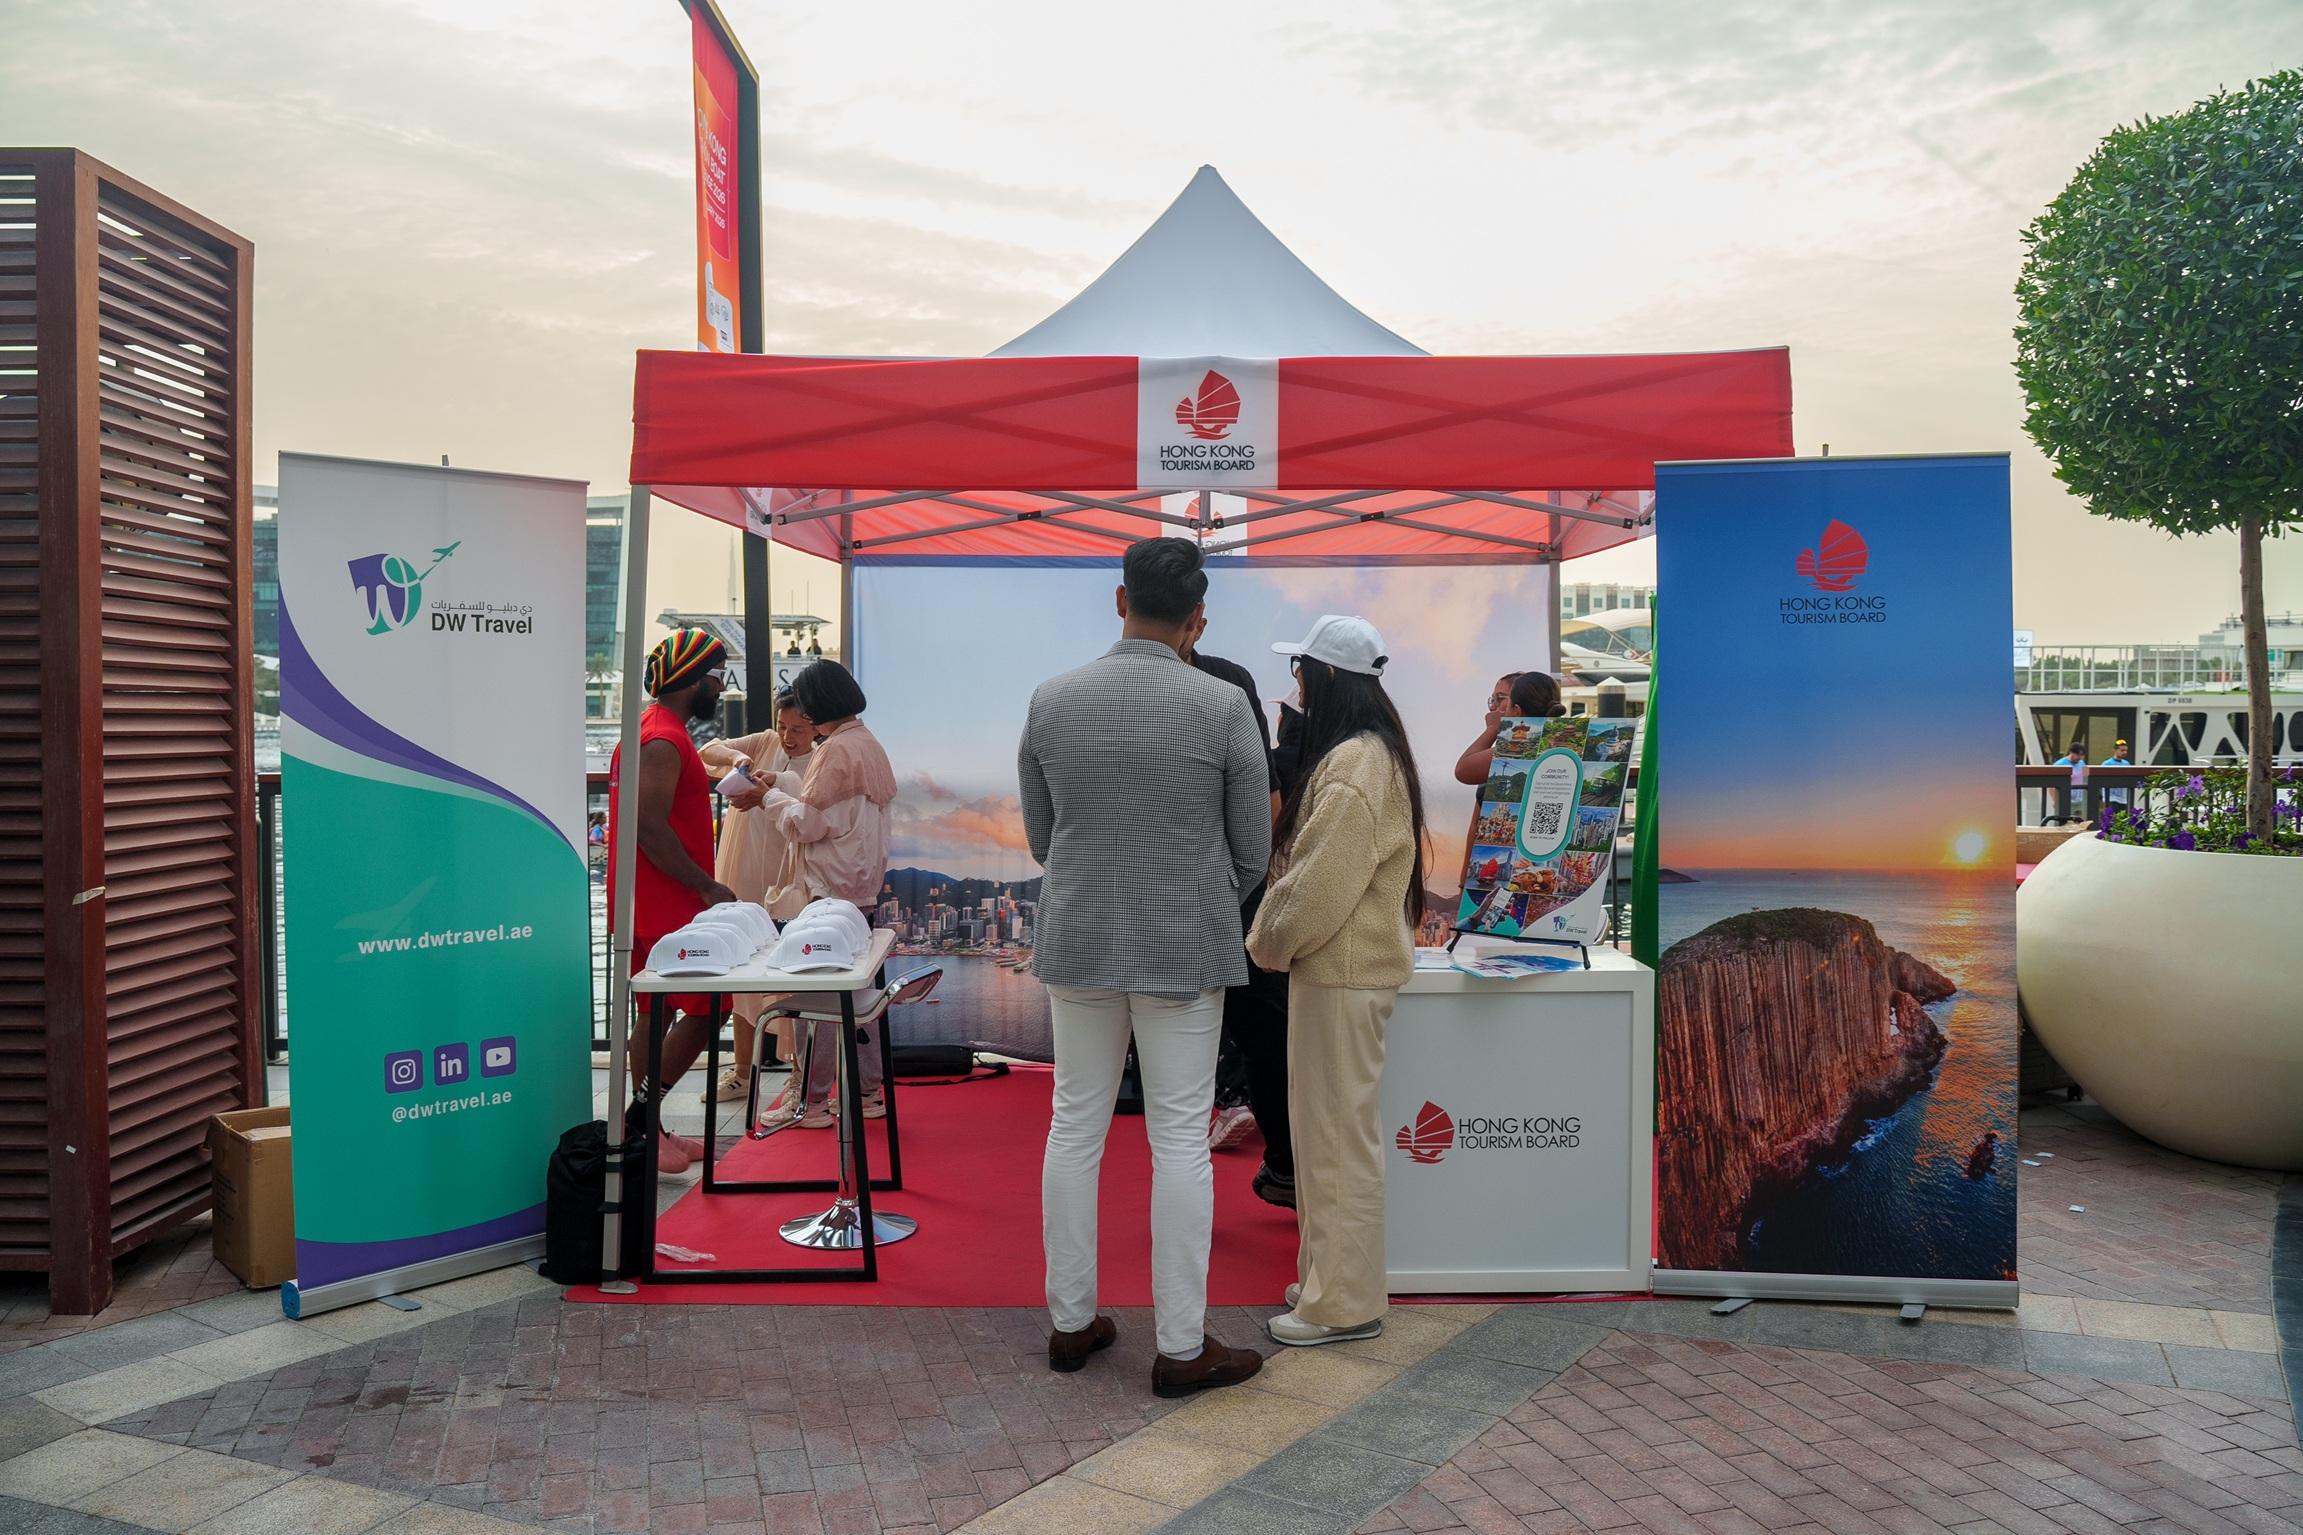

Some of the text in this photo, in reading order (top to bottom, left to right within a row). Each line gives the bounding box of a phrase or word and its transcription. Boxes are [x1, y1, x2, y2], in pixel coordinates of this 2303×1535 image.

[1160, 445, 1255, 458] HONG KONG
[1160, 460, 1255, 471] TOURISM BOARD
[520, 605, 533, 616] دي
[1780, 596, 1886, 611] HONG KONG
[432, 613, 532, 634] DW Travel
[1780, 612, 1886, 625] TOURISM BOARD
[358, 924, 533, 954] www.dwtravel.ae
[440, 1053, 462, 1078] in
[392, 1091, 512, 1123] @dwtravel.ae
[1459, 1117, 1581, 1134] HONG KONG
[1459, 1135, 1580, 1149] TOURISM BOARD
